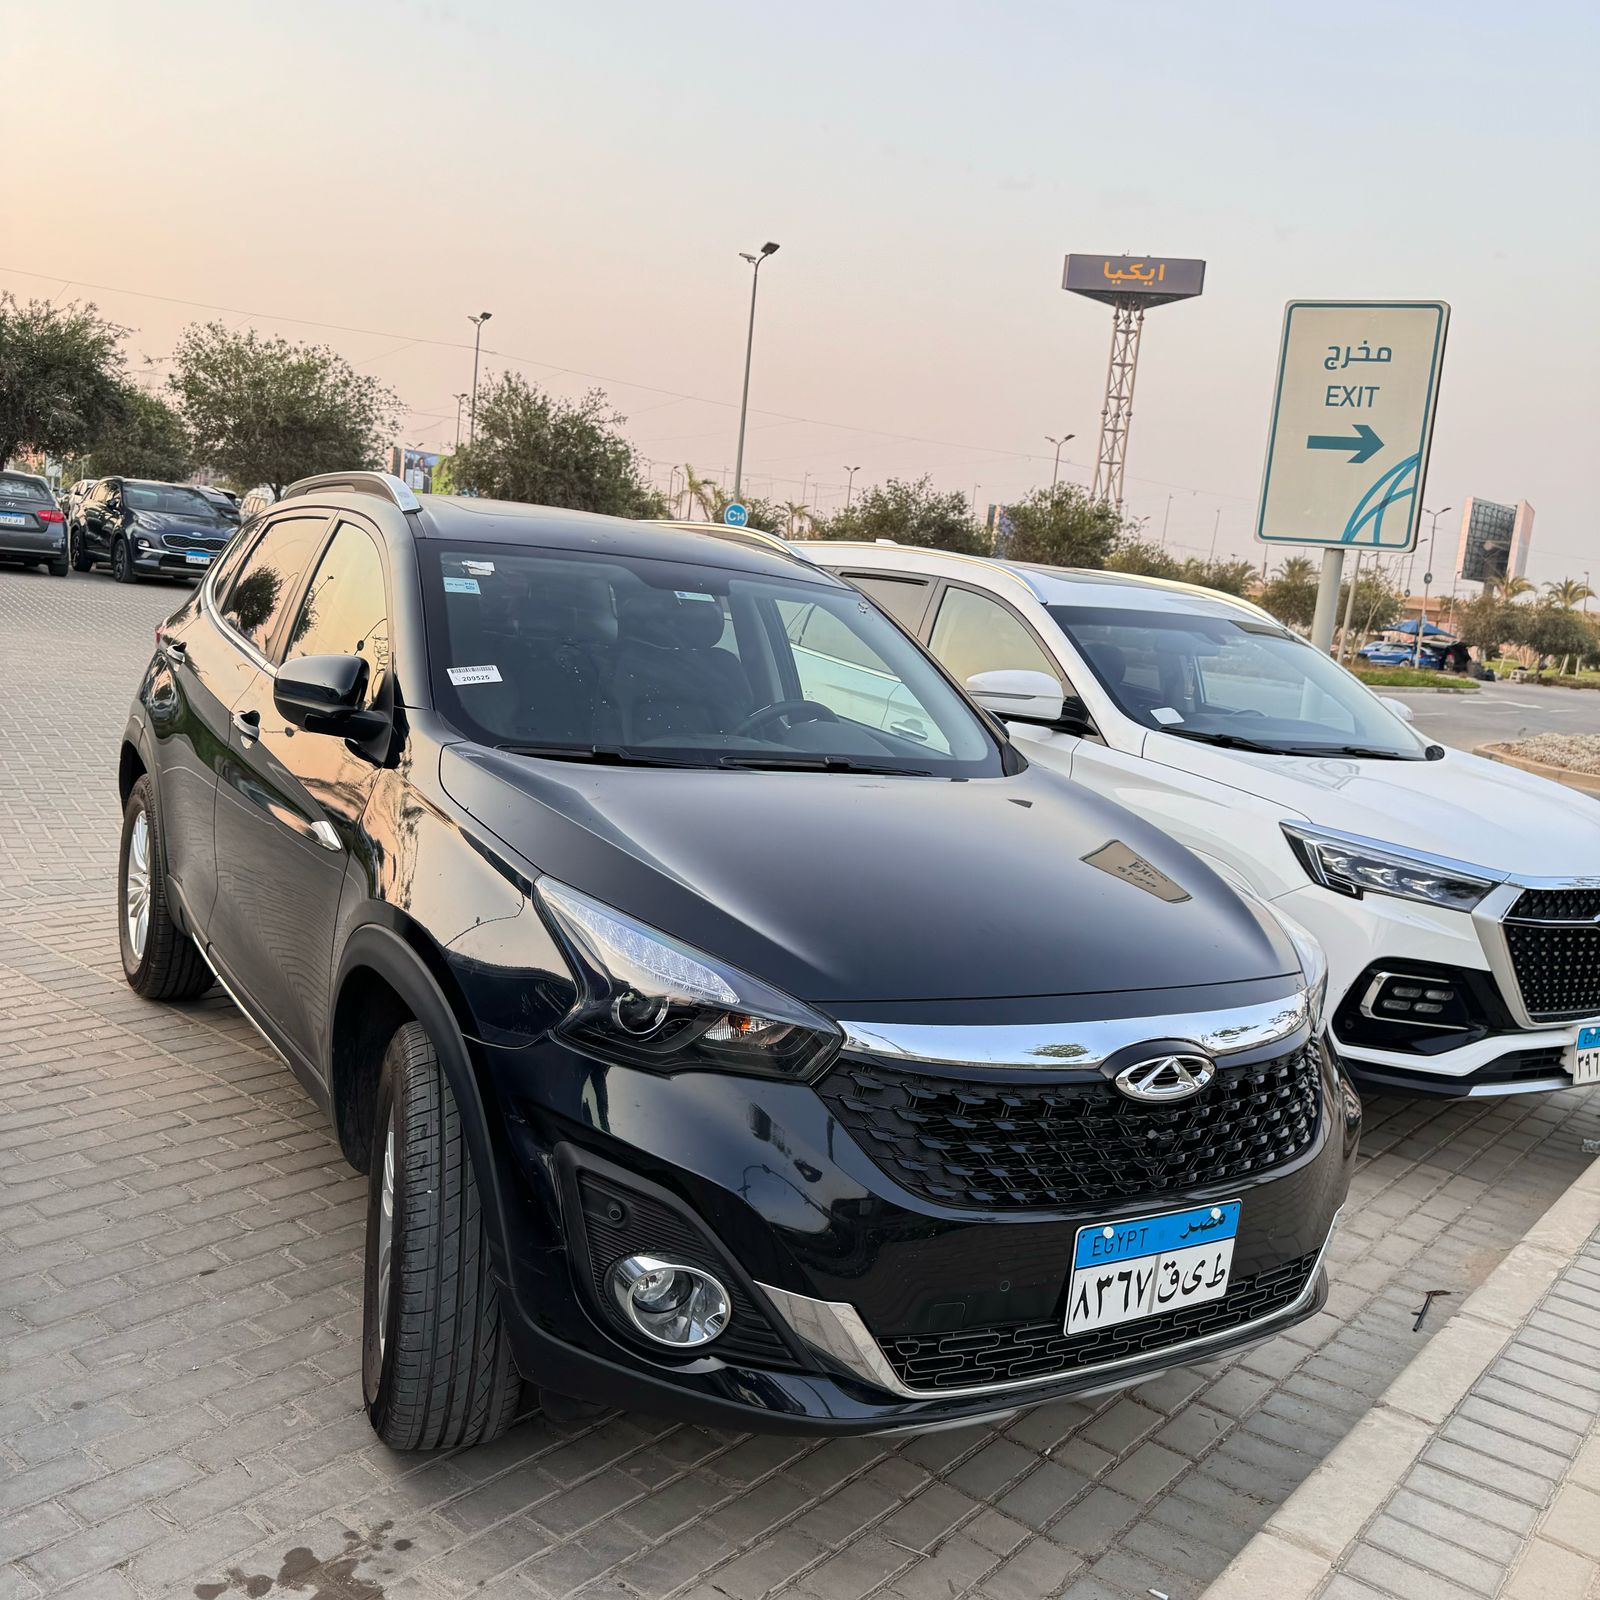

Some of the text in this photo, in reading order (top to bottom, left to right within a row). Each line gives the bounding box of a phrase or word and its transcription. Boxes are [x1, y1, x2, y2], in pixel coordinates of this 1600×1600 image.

[1103, 261, 1165, 286] ايكيا
[1323, 340, 1392, 370] مخرج
[1325, 385, 1381, 408] EXIT
[1180, 1212, 1226, 1240] مصر
[1092, 1227, 1149, 1256] EGYPT
[1073, 1267, 1153, 1322] ٨٣٦٧
